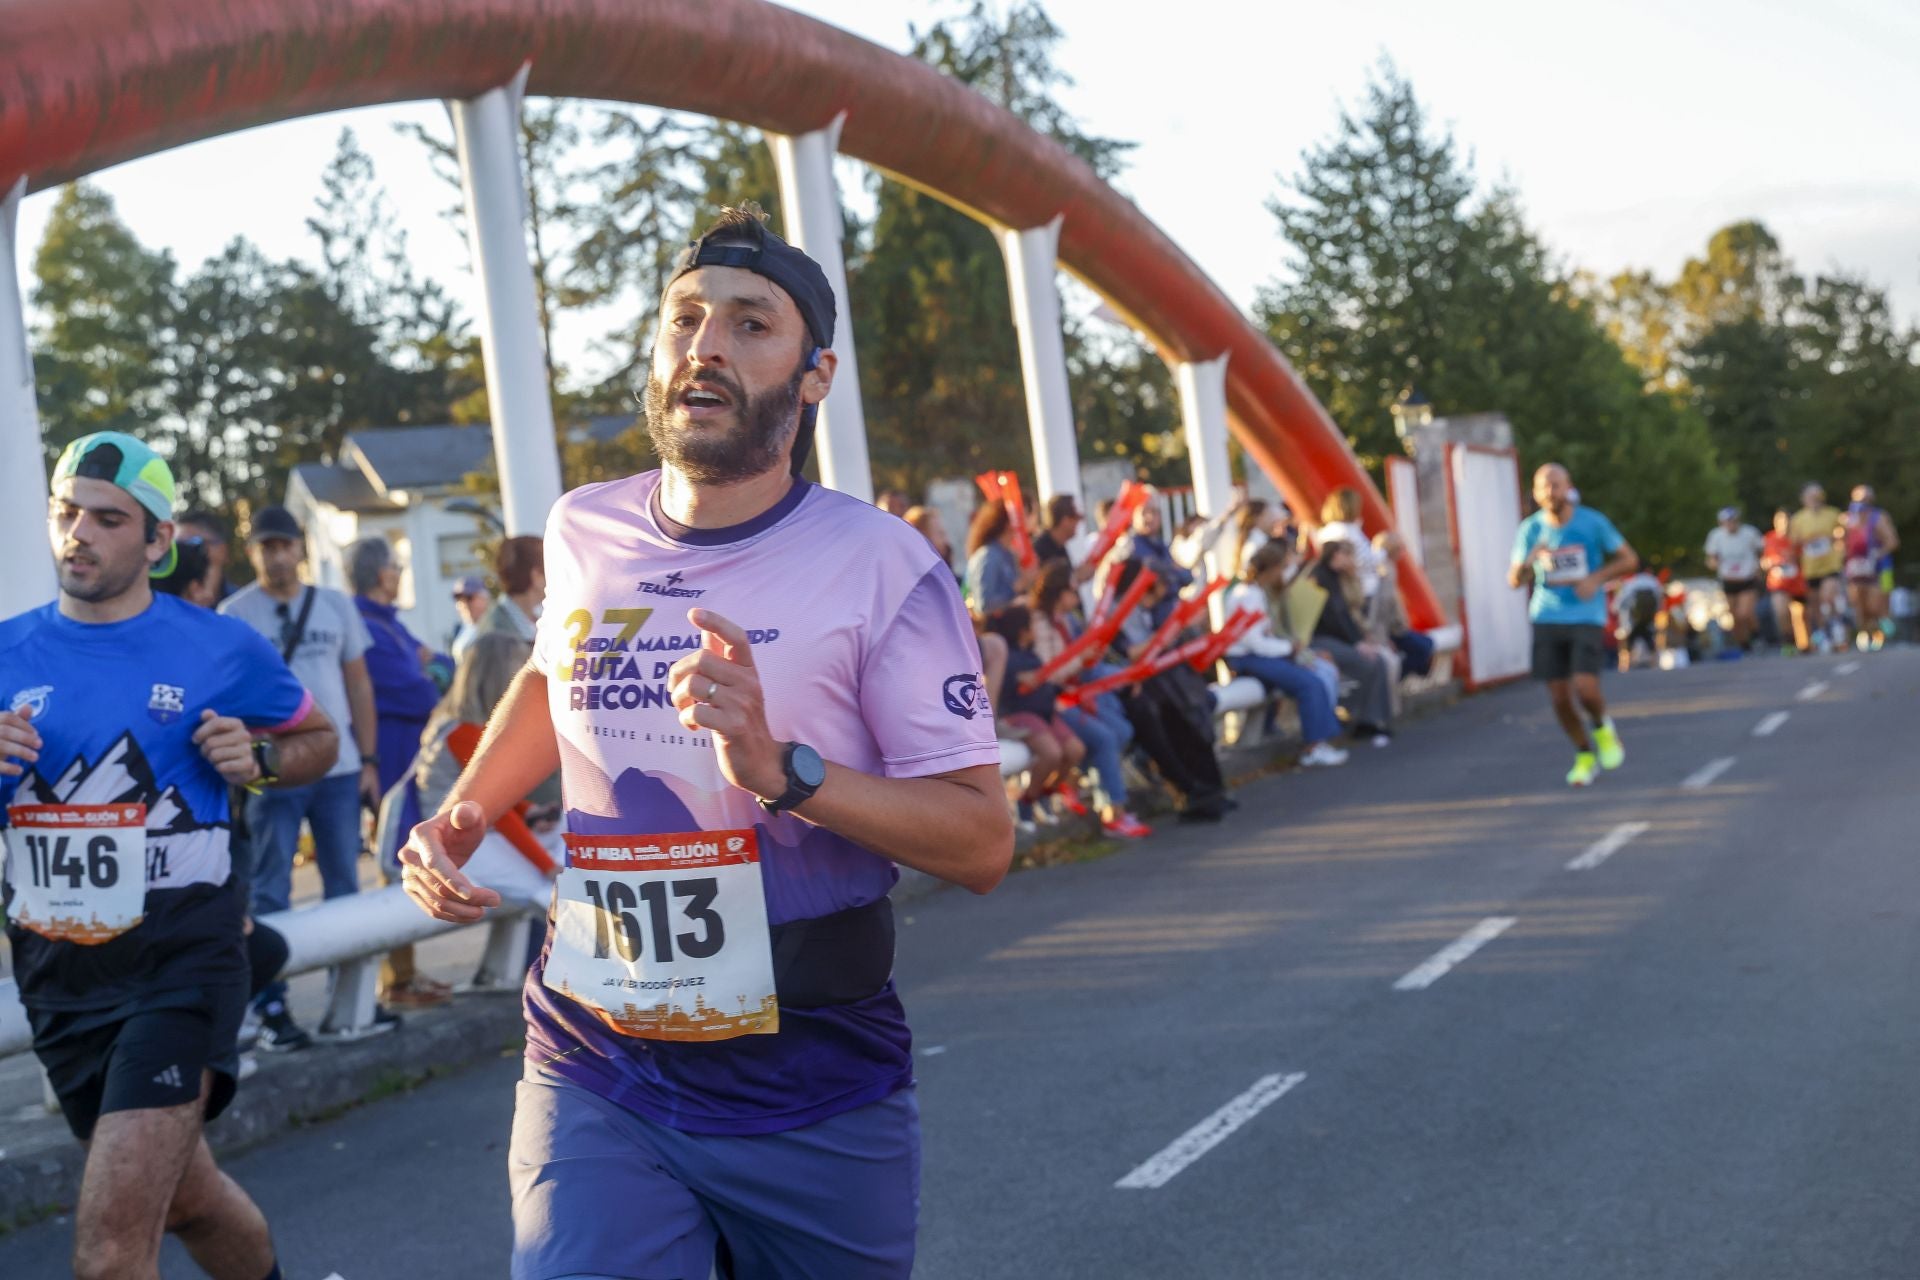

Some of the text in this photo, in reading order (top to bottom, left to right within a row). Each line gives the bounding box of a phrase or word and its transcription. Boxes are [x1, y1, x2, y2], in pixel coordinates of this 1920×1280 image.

[556, 608, 654, 681] 37
[572, 655, 642, 681] RUTA
[576, 637, 629, 652] MEDIA
[638, 634, 702, 652] MARAT
[26, 835, 118, 889] 1146
[585, 877, 725, 963] 1613
